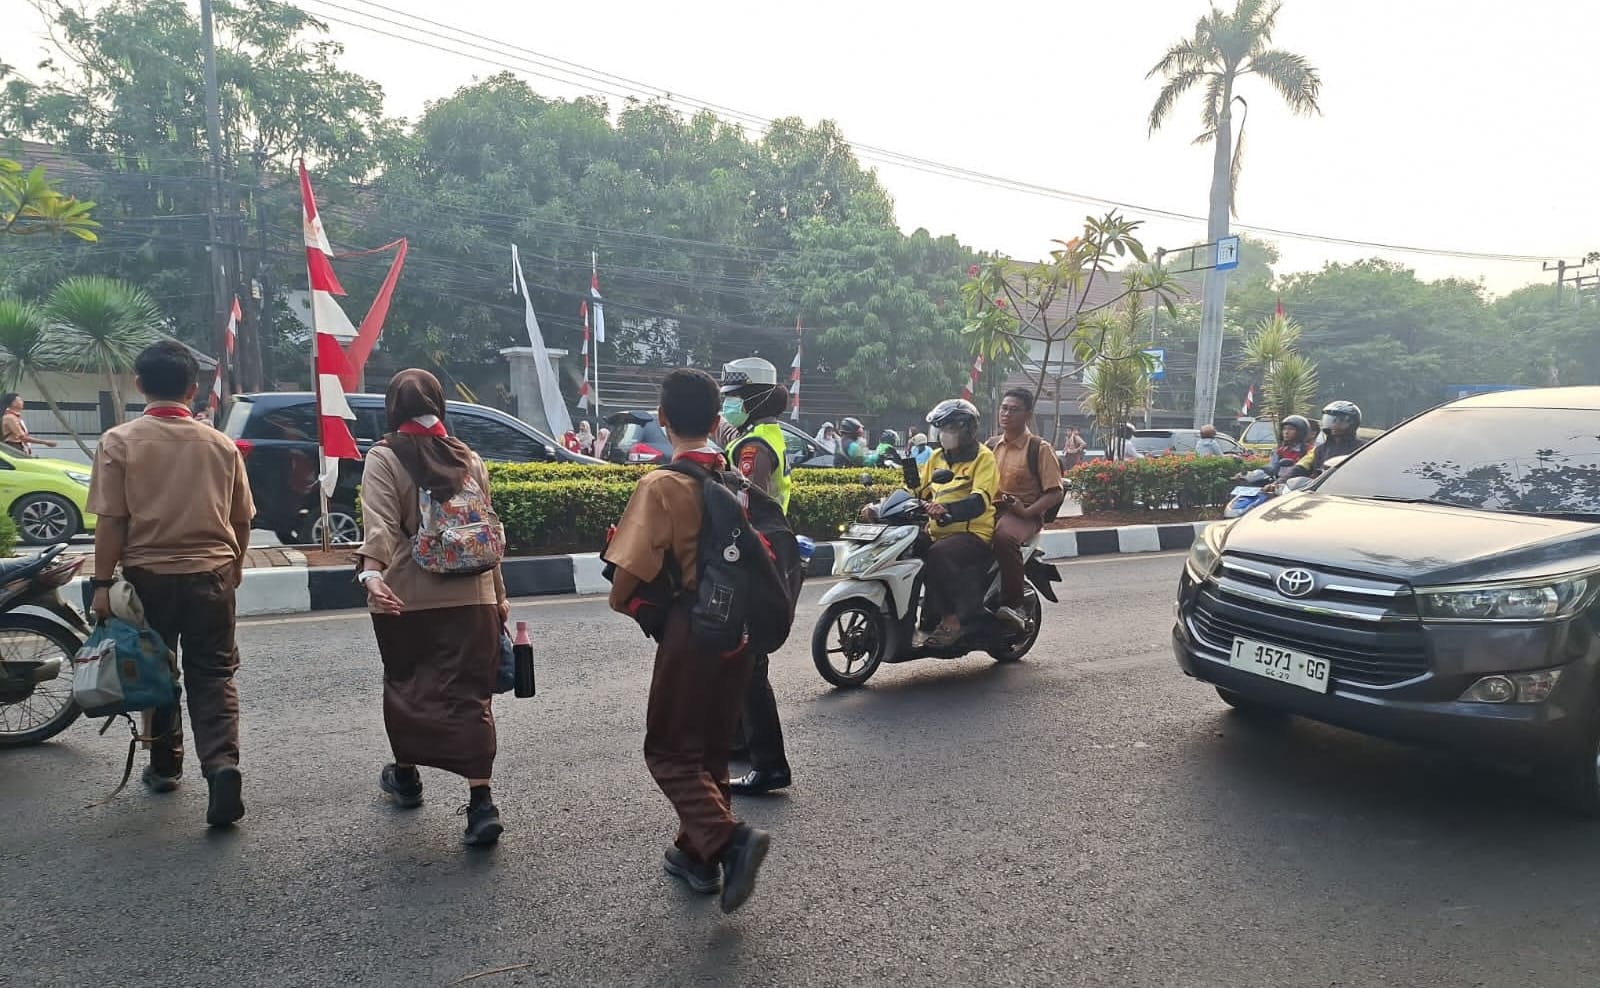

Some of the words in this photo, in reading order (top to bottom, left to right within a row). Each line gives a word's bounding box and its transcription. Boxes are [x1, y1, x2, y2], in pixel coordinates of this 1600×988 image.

[1236, 640, 1245, 658] T
[1255, 645, 1292, 671] 1571
[1306, 659, 1326, 680] GG
